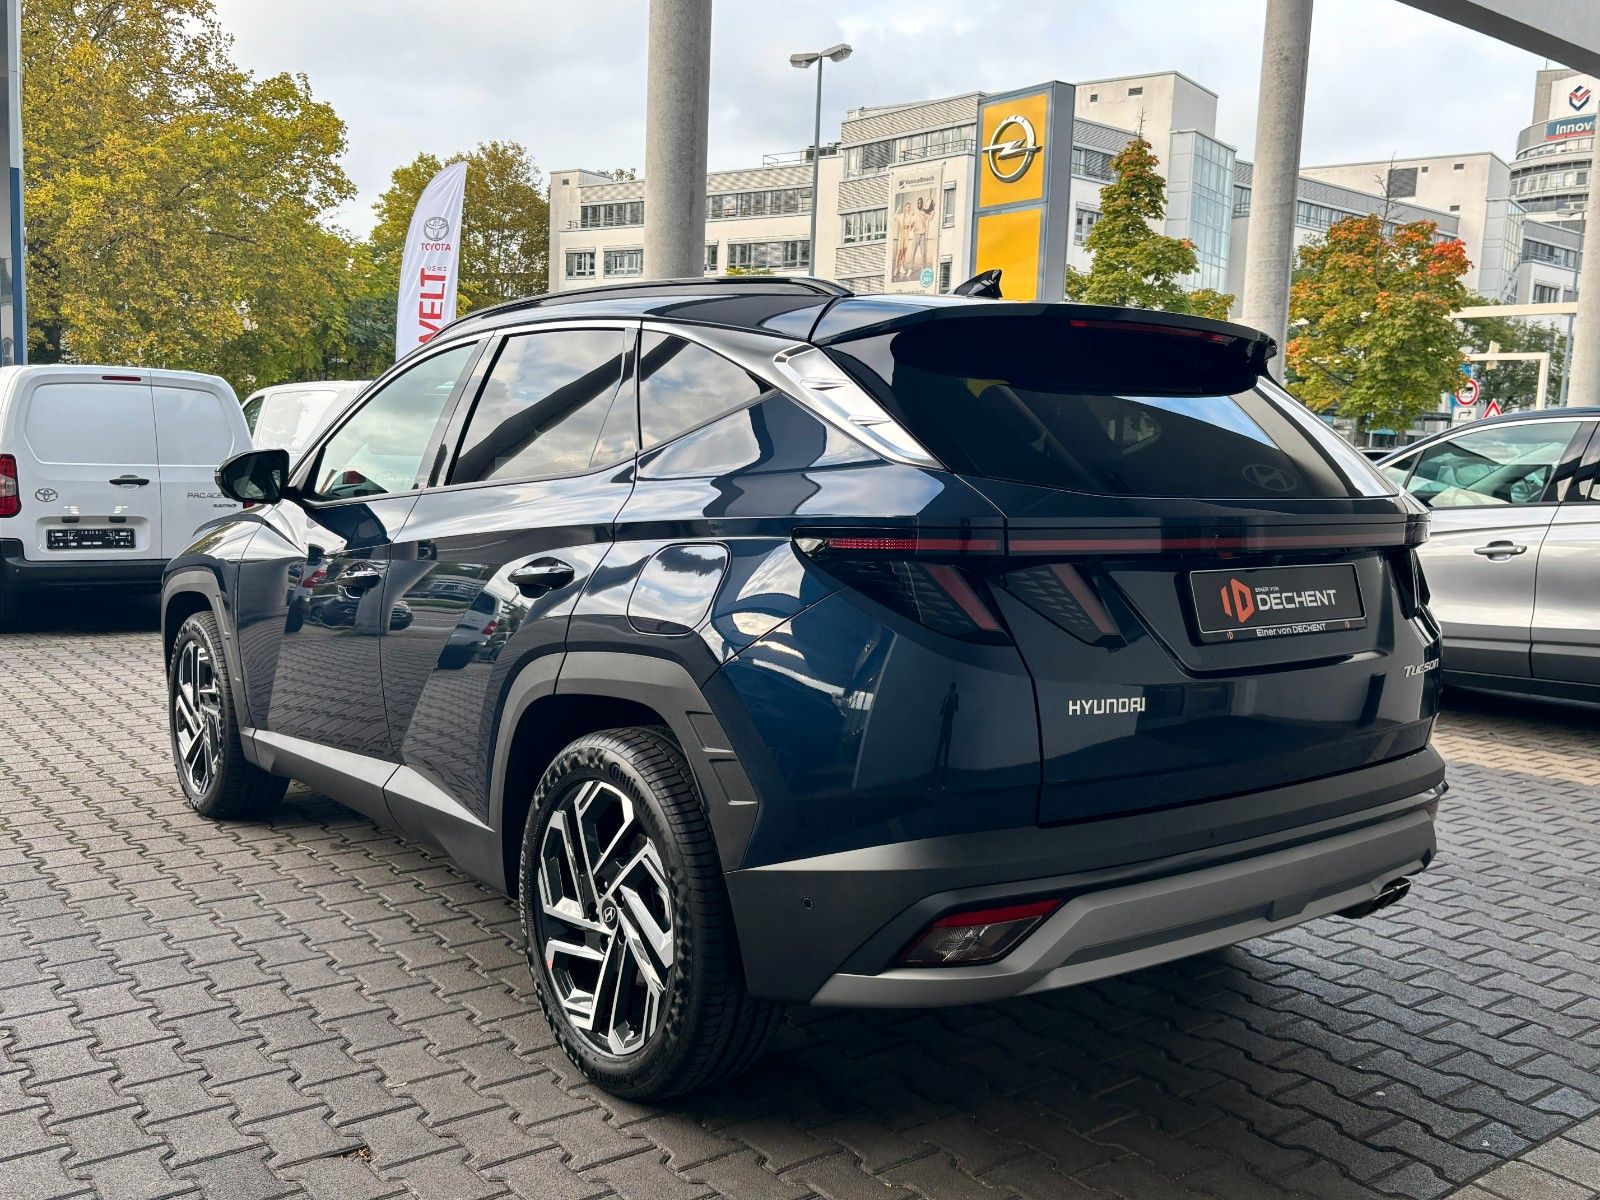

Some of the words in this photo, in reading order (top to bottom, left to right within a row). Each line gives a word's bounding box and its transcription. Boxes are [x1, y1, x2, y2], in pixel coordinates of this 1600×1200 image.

[421, 242, 451, 251] TOYOTA
[1256, 590, 1337, 611] DECHENT
[1256, 628, 1276, 637] Einer
[1277, 627, 1292, 635] von
[1292, 623, 1327, 634] DECHENT
[1068, 696, 1146, 716] HYUNDAI
